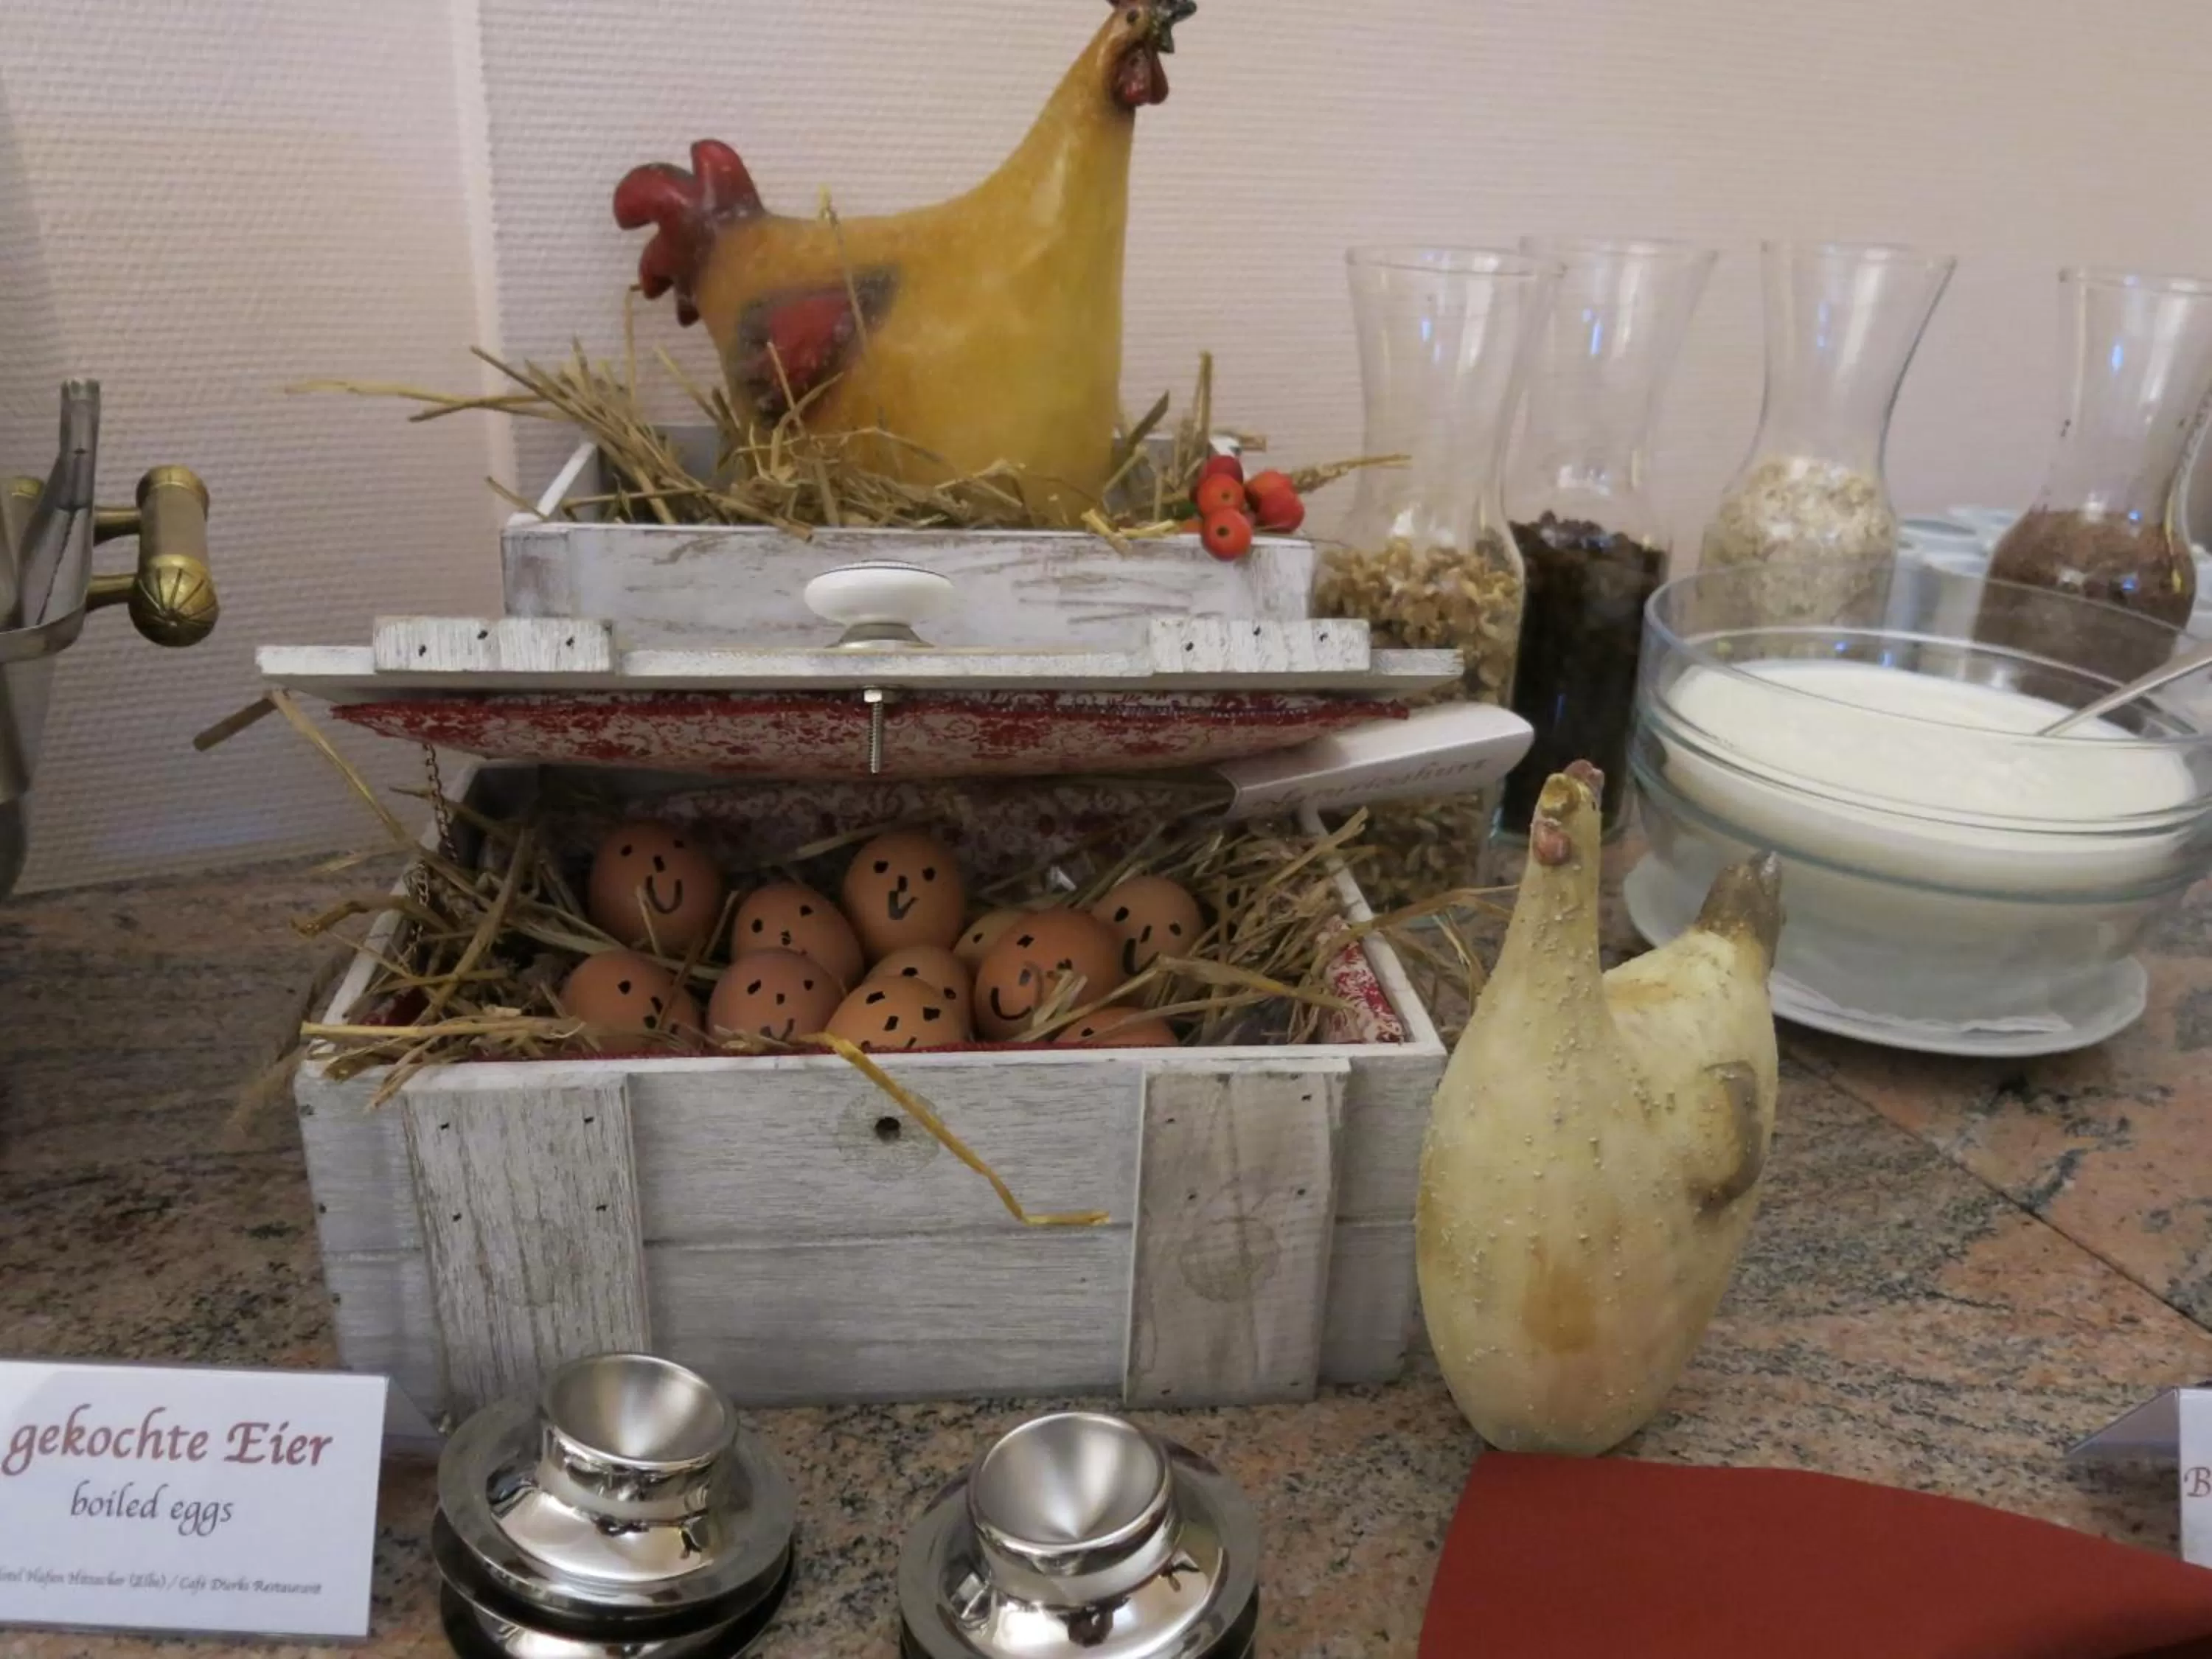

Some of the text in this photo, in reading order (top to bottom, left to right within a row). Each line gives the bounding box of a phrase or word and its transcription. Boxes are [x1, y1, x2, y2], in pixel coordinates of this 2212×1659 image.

[1, 1403, 333, 1475] gekochte Eier
[70, 1479, 234, 1537] boiled eggs
